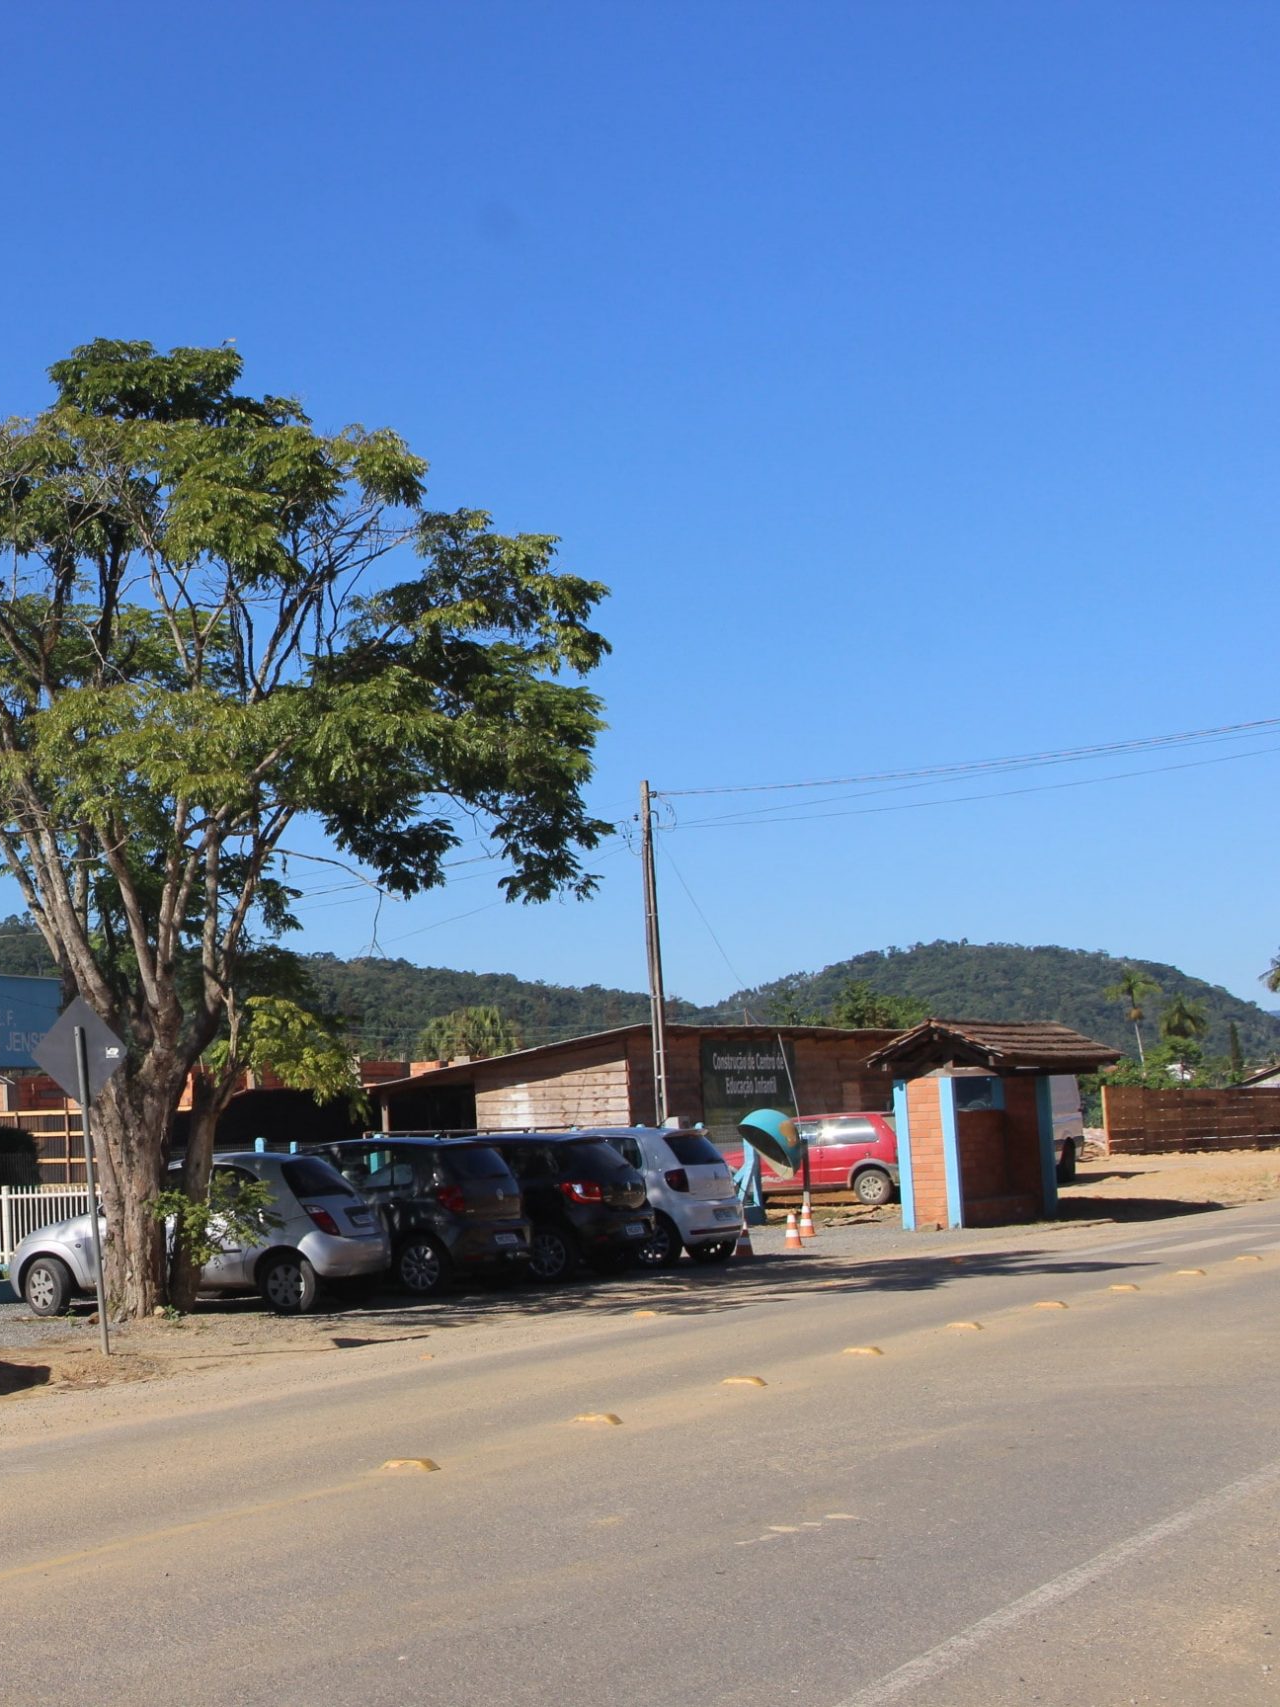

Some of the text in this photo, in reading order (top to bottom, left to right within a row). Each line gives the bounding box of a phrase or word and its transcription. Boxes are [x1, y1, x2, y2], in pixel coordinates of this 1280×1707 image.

[712, 1051, 784, 1074] Construção de Centro de
[725, 1075, 777, 1098] Educação Infantil
